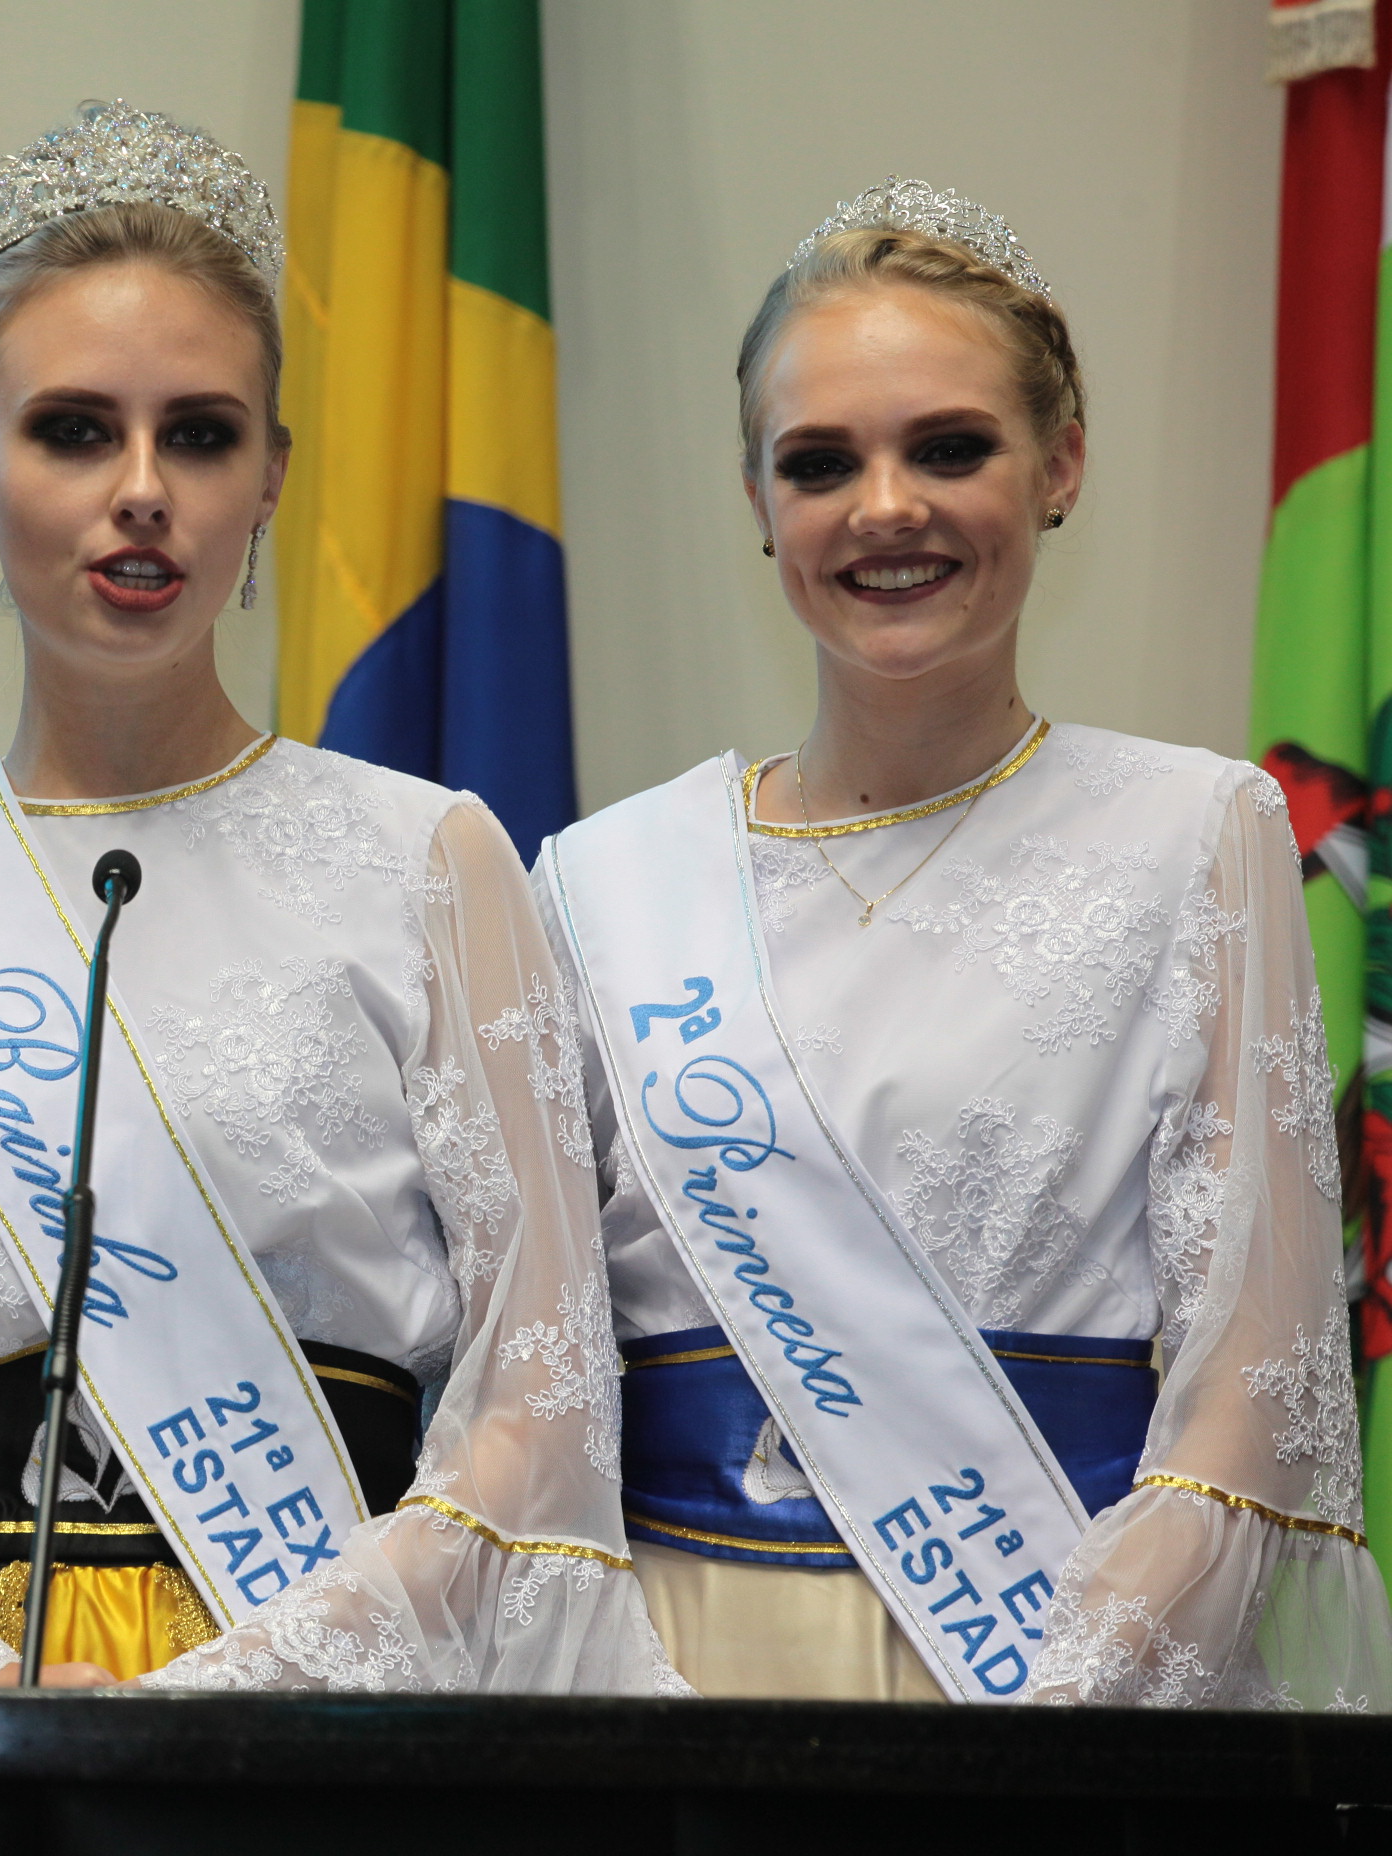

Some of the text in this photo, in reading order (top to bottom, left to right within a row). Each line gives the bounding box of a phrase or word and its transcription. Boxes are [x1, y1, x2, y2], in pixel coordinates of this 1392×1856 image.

[641, 1055, 865, 1419] Princesa
[145, 1405, 293, 1607] ESTAD
[265, 1485, 341, 1575] EX
[871, 1495, 1029, 1696] ESTAD
[998, 1568, 1055, 1641] E
